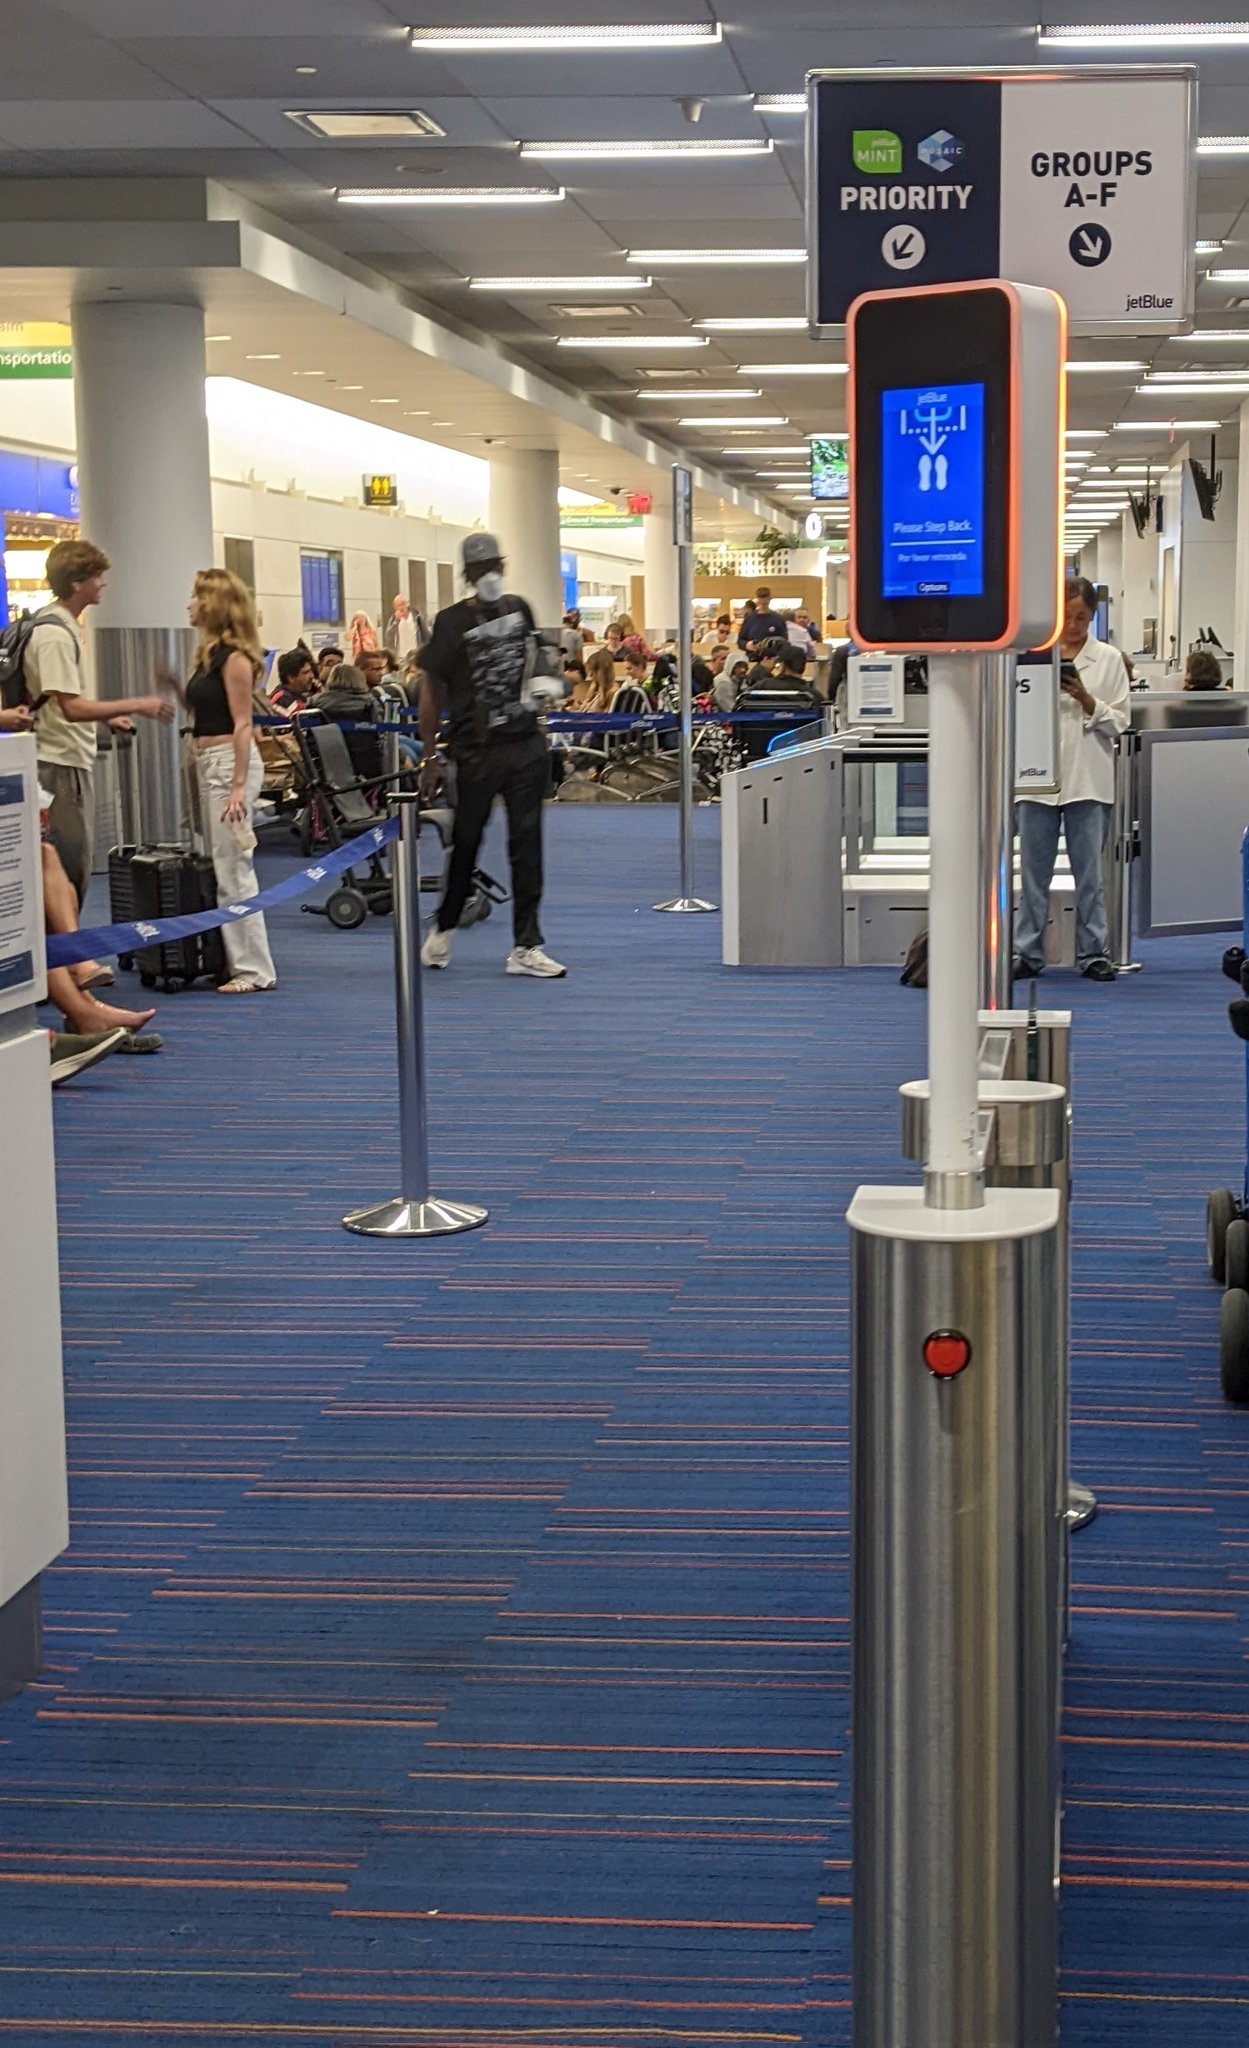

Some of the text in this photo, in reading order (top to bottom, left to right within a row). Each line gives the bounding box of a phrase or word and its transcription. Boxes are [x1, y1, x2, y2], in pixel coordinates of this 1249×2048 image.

[857, 149, 898, 163] MINT
[1030, 150, 1153, 178] GROUPS
[840, 185, 974, 211] PRIORITY
[1064, 182, 1118, 208] A-F
[1125, 294, 1174, 312] jetBlue
[893, 522, 923, 533] Please
[924, 521, 947, 535] Step
[919, 582, 948, 594] Options
